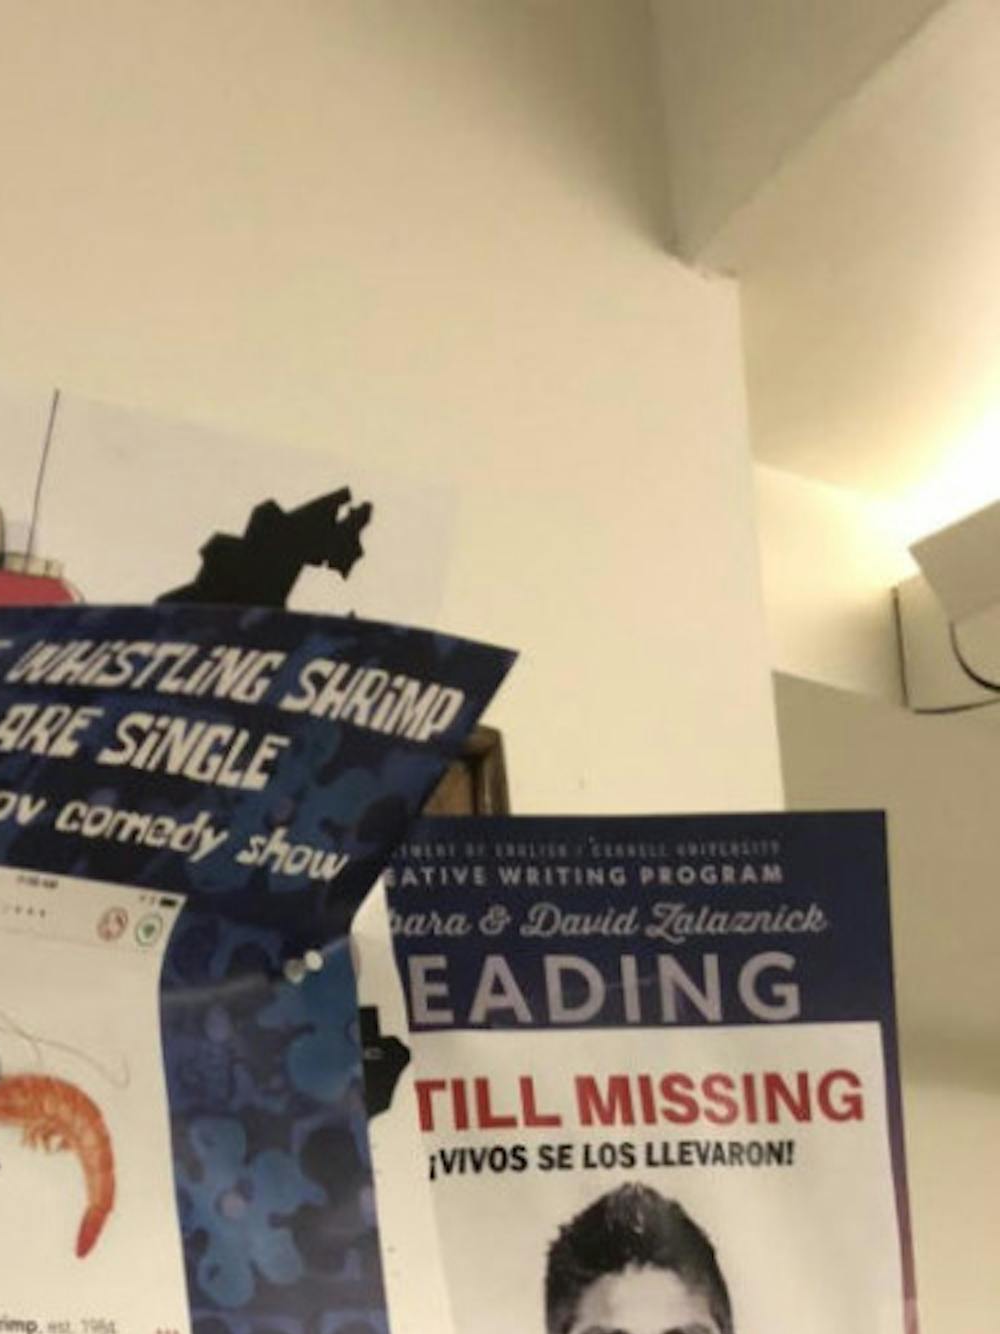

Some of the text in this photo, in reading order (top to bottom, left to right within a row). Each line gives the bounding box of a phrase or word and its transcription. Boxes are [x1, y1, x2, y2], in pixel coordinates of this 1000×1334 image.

[55, 798, 229, 864] comedy
[236, 825, 352, 885] show
[499, 865, 628, 887] WRITING
[640, 863, 784, 886] PROGRAM
[478, 902, 511, 936] &
[519, 902, 640, 938] David
[645, 901, 830, 944] Zalaznick
[574, 1069, 865, 1128] MISSING
[537, 1143, 575, 1172] SE
[582, 1141, 638, 1169] LOS
[645, 1139, 795, 1168] LLEVARON!
